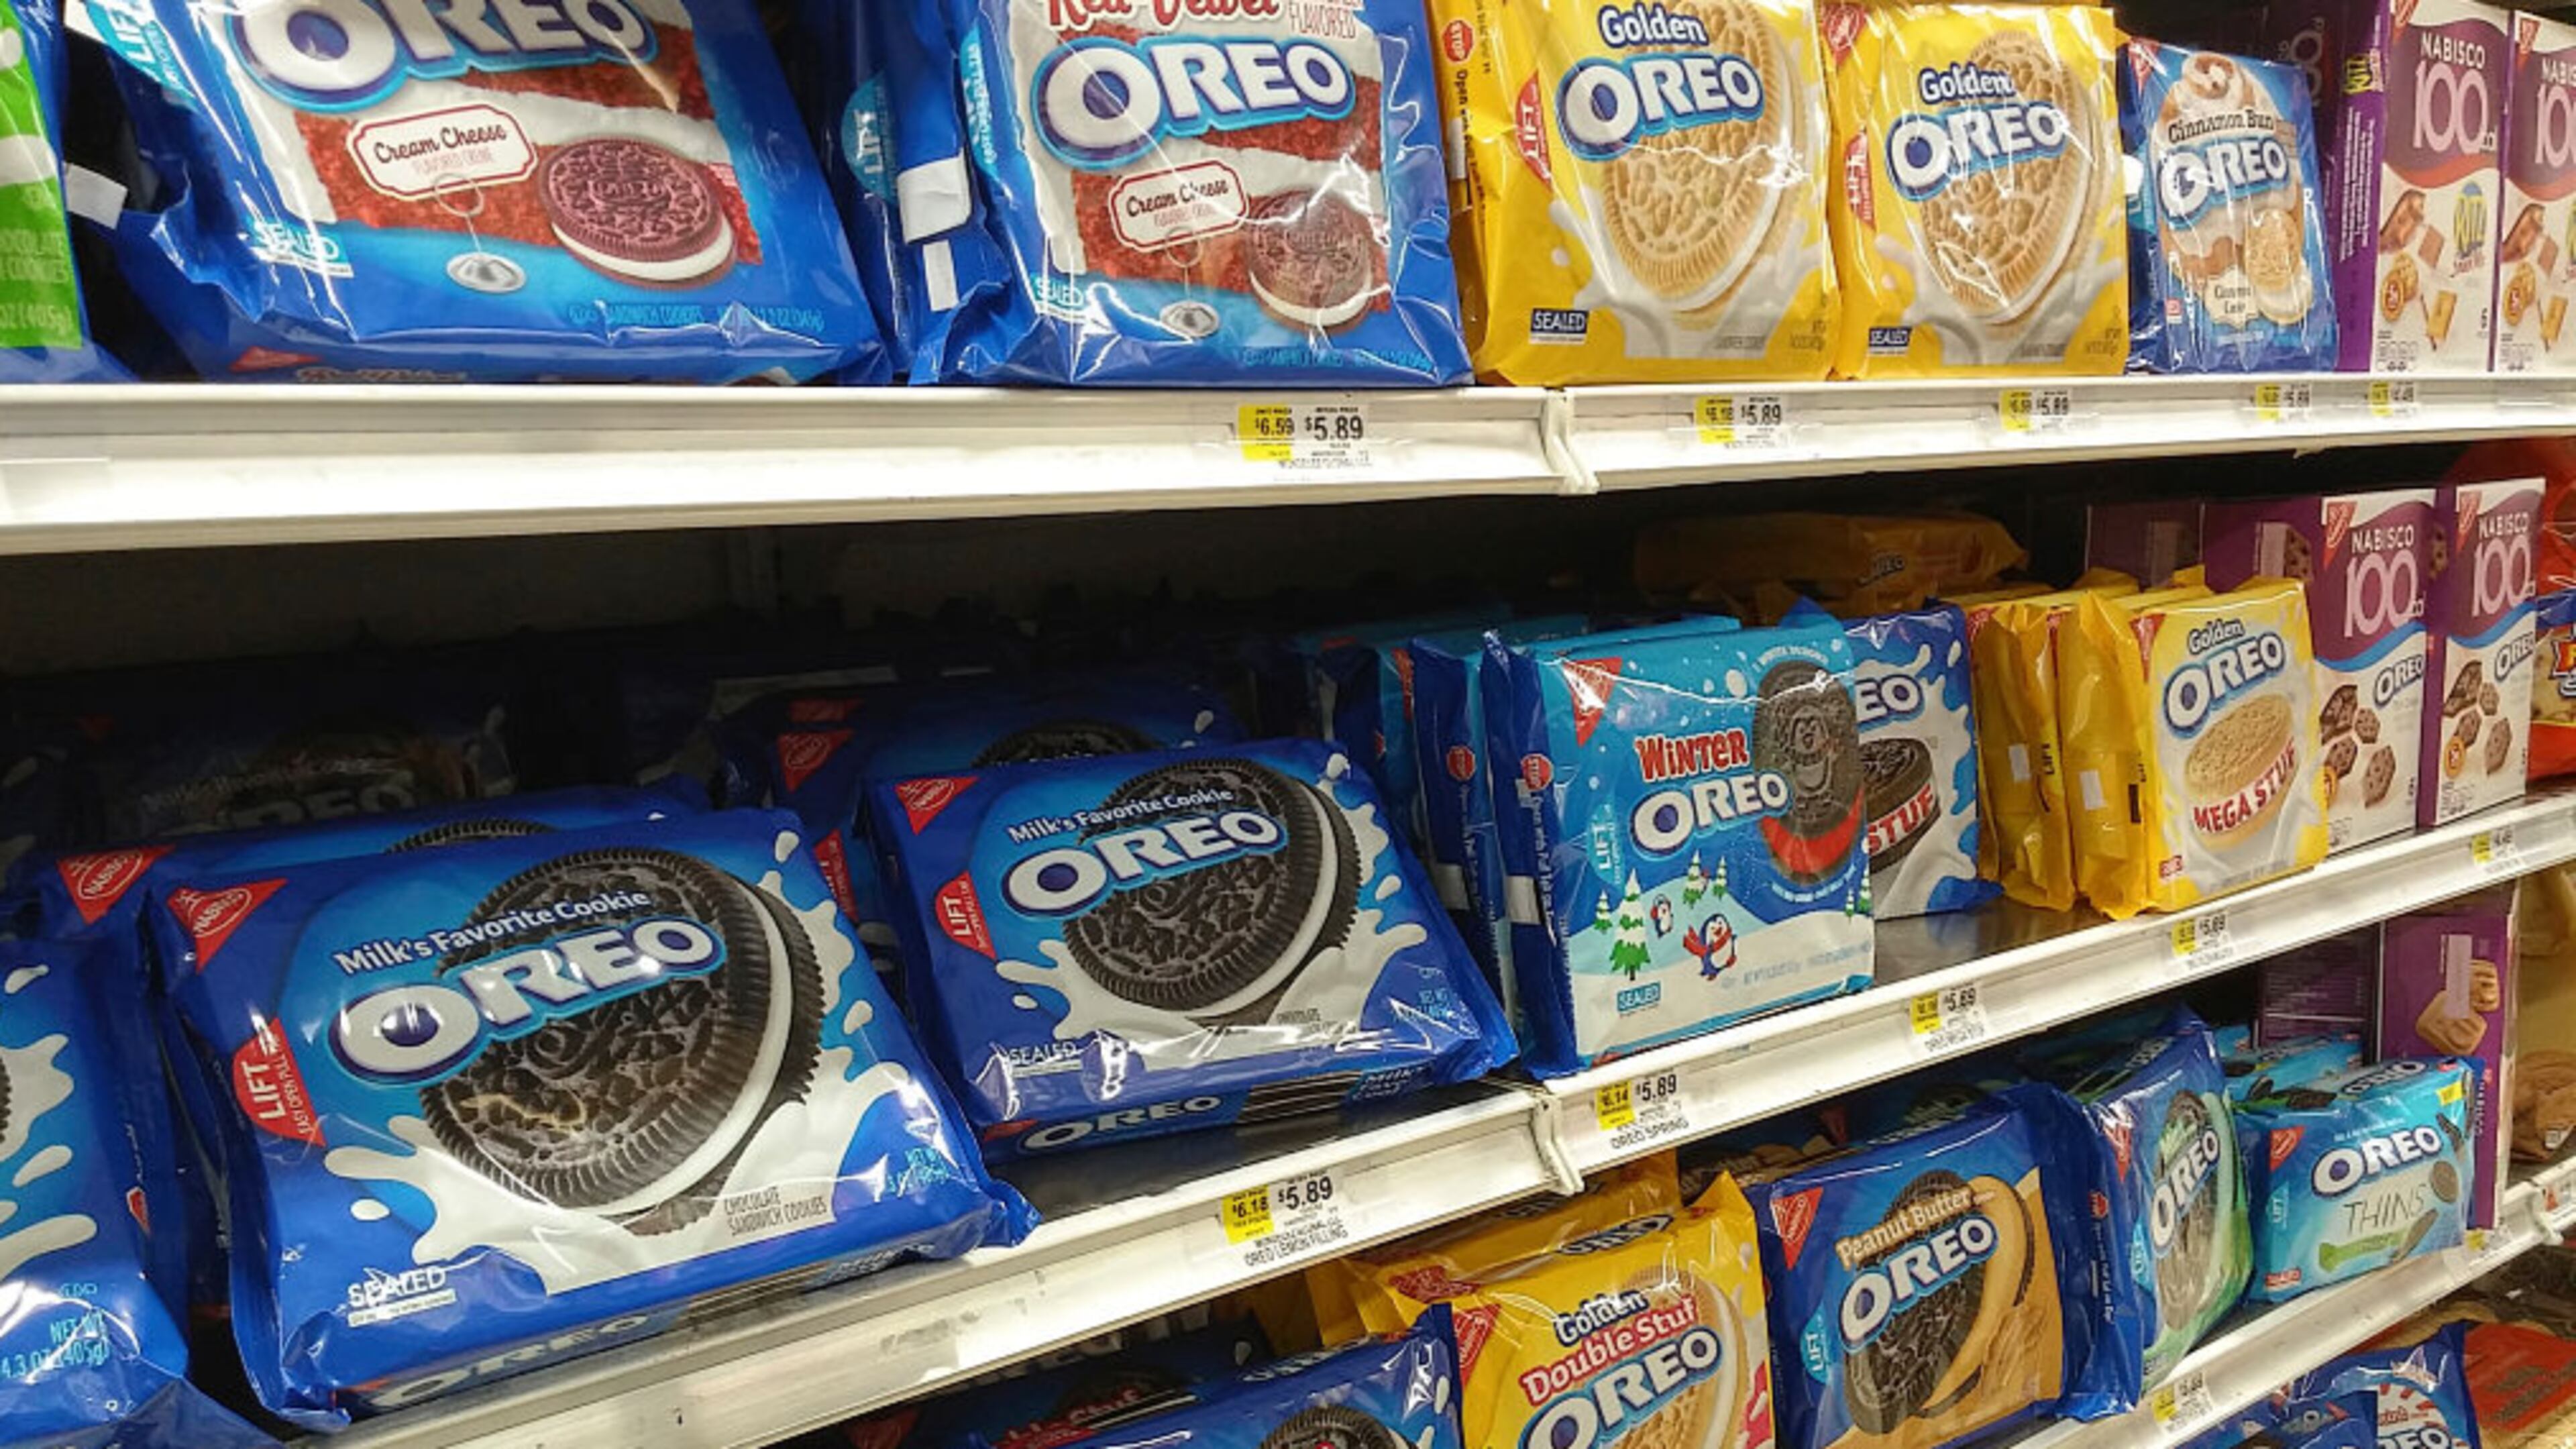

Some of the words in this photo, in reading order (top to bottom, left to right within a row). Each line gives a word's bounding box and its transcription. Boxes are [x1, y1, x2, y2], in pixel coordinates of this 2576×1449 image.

[240, 0, 647, 91] OREO
[1599, 7, 1709, 45] Golden
[2420, 31, 2486, 68] NABISCO
[1044, 43, 1348, 149] OREO
[1563, 58, 1762, 145] OREO
[1919, 66, 2014, 103] Golden
[2413, 62, 2489, 154] 100
[373, 138, 441, 166] Cream
[441, 117, 508, 150] Cheese
[1519, 103, 1540, 162] LIFT
[1890, 105, 2068, 189] OREO
[2168, 113, 2245, 144] Cinnamon
[2245, 109, 2274, 131] Bun
[2535, 85, 2576, 168] 10
[1126, 189, 1178, 217] Cream
[2159, 139, 2289, 216] OREO
[1532, 311, 1588, 333] SEALED
[1254, 417, 1296, 436] $6.59
[1305, 414, 1364, 441] $5.89
[2351, 523, 2415, 554] NABISCO
[2478, 512, 2530, 538] NABISCO
[2344, 549, 2418, 638] 100
[2472, 536, 2533, 616] 100
[2188, 618, 2245, 655] Golden
[1856, 674, 1920, 720] EO
[2166, 635, 2284, 729] OREO
[1006, 816, 1077, 845] Milk's
[1076, 799, 1163, 828] Favorite
[1165, 786, 1236, 810] Cookie
[1634, 775, 1790, 852] OREO
[2194, 793, 2253, 834] MEGA
[2255, 741, 2296, 807] STUF
[1008, 812, 1279, 912] OREO
[1595, 825, 1612, 871] LIFT
[334, 932, 434, 976] Milk's
[435, 906, 555, 955] Favorite
[556, 890, 652, 922] Cookie
[943, 896, 972, 936] LIFT
[338, 920, 714, 1075] OREO
[1618, 986, 1660, 1009] SEALED
[1009, 1042, 1079, 1065] SEALED
[240, 1061, 286, 1120] LIFT
[1635, 1073, 1677, 1102] $5.89
[1023, 1095, 1223, 1150] OREO
[2151, 1128, 2220, 1249] OREO
[2312, 1127, 2443, 1193] OREO
[723, 1186, 782, 1216] CHOCOLATE
[727, 1207, 785, 1238] SANDWICH
[785, 1196, 829, 1225] COOKIES
[1278, 1175, 1334, 1210] $5.89
[2343, 1184, 2430, 1236] THINS
[1835, 1218, 1912, 1269] Peanut
[1913, 1188, 1972, 1226] Butter
[346, 1268, 447, 1309] SEALED
[1841, 1217, 1996, 1342] OREO
[1556, 1291, 1646, 1342] Golden
[376, 1313, 649, 1408] OREO
[1521, 1324, 1635, 1403] Double
[1637, 1295, 1699, 1340] Stuf
[1807, 1330, 1823, 1372] LIFT
[1528, 1328, 1720, 1449] OREO
